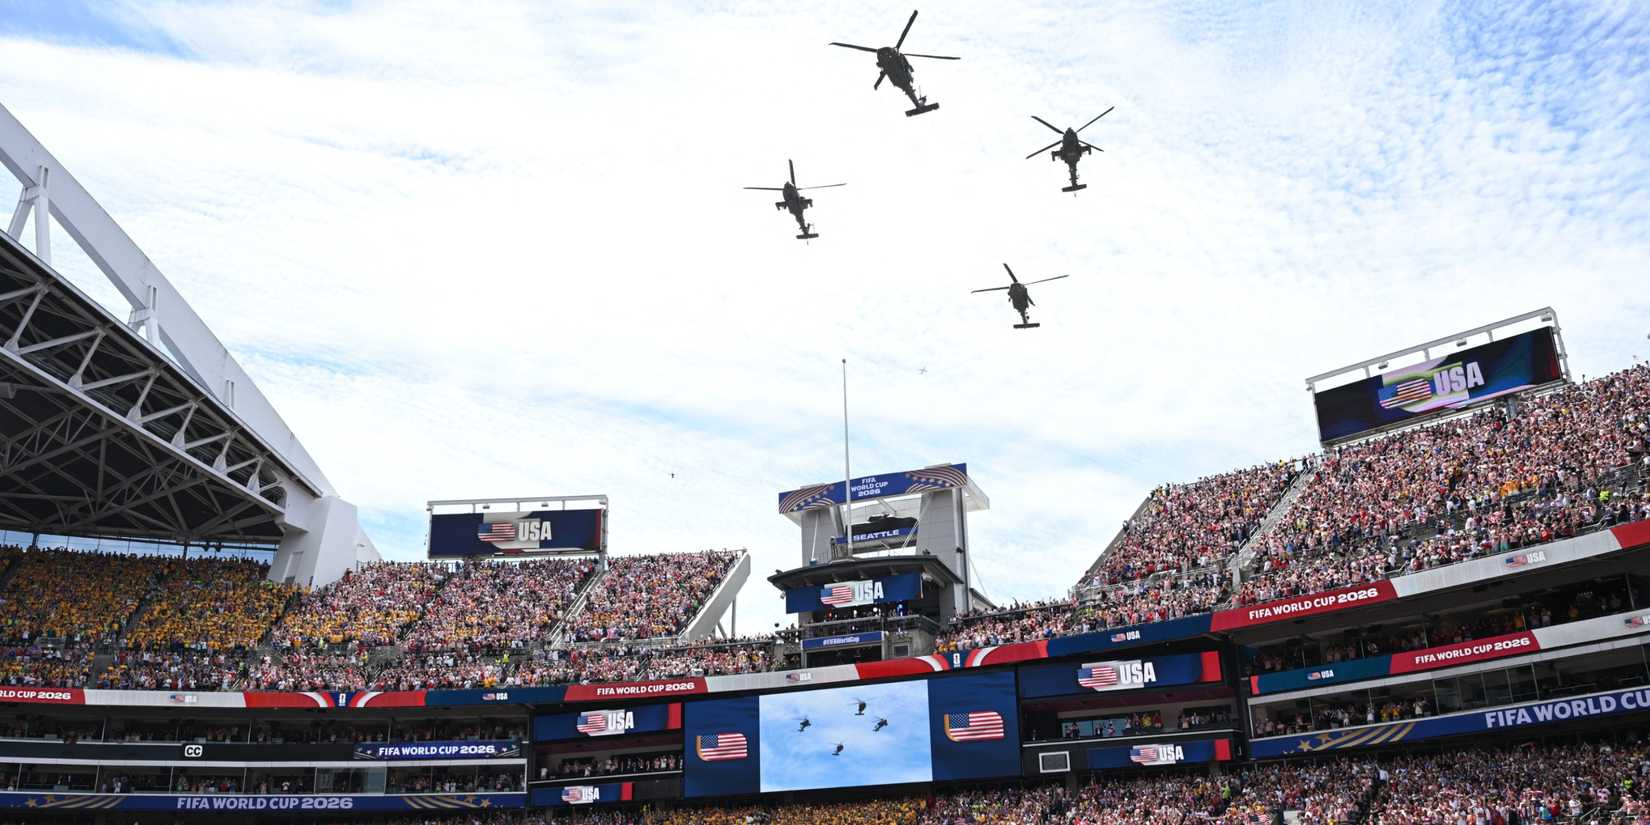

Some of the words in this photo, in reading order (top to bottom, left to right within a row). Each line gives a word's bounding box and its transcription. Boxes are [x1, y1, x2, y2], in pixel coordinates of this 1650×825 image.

[1434, 361, 1485, 396] USA
[851, 484, 874, 492] WORLD
[858, 489, 881, 497] 2026
[518, 521, 552, 541] USA
[853, 529, 899, 541] SEATTLE
[1526, 551, 1545, 564] USA
[855, 581, 884, 600] USA
[1249, 610, 1272, 620] FIFA
[1272, 601, 1312, 616] WORLD
[1313, 596, 1336, 608] CUP
[1337, 587, 1378, 603] 2026
[1126, 631, 1140, 640] USA
[1415, 654, 1436, 664] FIFA
[1436, 647, 1471, 660] WORLD
[1472, 644, 1493, 655] CUP
[1494, 637, 1530, 651] 2026
[1119, 661, 1156, 684] USA
[1321, 670, 1334, 679] USA
[17, 691, 36, 699] CUP
[37, 692, 71, 700] 2026
[597, 687, 615, 696] FIFA
[616, 685, 646, 694] WORLD
[647, 684, 664, 692] CUP
[665, 682, 695, 691] 2026
[1485, 709, 1531, 728] FIFA
[1533, 694, 1616, 722] WORLD
[608, 711, 634, 730] USA
[186, 746, 201, 756] CC
[378, 747, 400, 755] FIFA
[401, 746, 437, 755] WORLD
[438, 745, 458, 754] CUP
[459, 745, 495, 754] 2026
[1159, 746, 1184, 761] USA
[582, 787, 599, 800] USA
[177, 797, 209, 809] FIFA
[212, 797, 267, 809] WORLD
[269, 797, 299, 809] CUP
[301, 797, 353, 809] 2026
